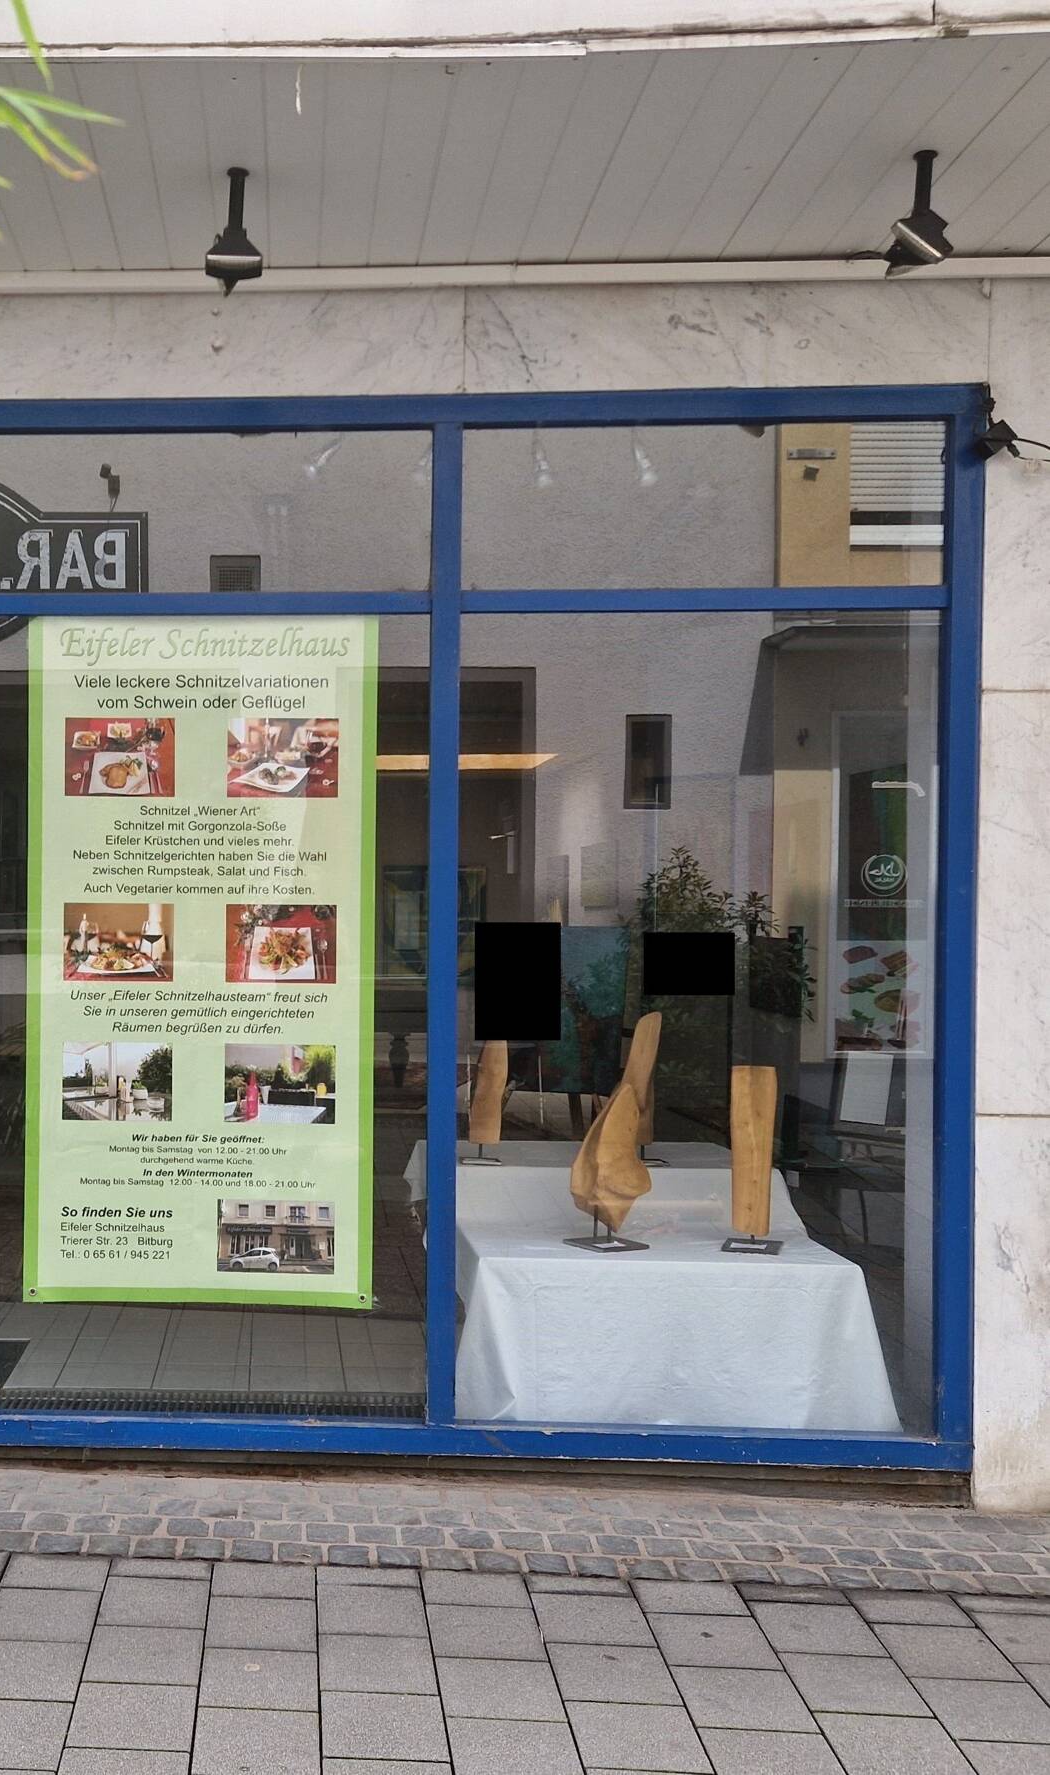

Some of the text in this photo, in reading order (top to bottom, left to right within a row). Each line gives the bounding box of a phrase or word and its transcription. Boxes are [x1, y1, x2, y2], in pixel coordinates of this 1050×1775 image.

[59, 627, 351, 667] Eifeler Schnitzelhaus
[75, 675, 329, 689] Viele leckere Schnitzelvariationen
[97, 695, 306, 712] vom Schwein oder Geflügel
[140, 806, 191, 816] Schnitzel
[114, 820, 287, 834] Schnitzel mit Gorgonzola-Soße
[105, 835, 295, 847] Eifeler Krüstchen und vieles mehr.
[73, 850, 327, 864] Neben Schnitzelgerichten haben Sie die Wahl
[92, 866, 307, 879] zwischen Rumpsteak, Salat und Fisch.
[84, 883, 315, 897] Auch Vegetarier kommen auf ihre Kosten.
[70, 990, 106, 1001] Unser
[274, 992, 301, 1003] freut
[304, 992, 328, 1003] sich
[83, 1006, 315, 1021] Sie in unseren gemütlich eingerichteten
[112, 1021, 284, 1036] Räumen begrüßen zu dürfen.
[131, 1134, 265, 1146] Wir haben für Sie geöffnet:
[109, 1146, 140, 1155] Montag
[142, 1146, 154, 1154] bis
[157, 1146, 193, 1155] Samstag
[271, 1147, 287, 1155] Uhr
[140, 1157, 194, 1166] durchgehend
[143, 1169, 253, 1178] In den Wintermonaten
[80, 1178, 111, 1187] Montag
[113, 1178, 125, 1186] bis
[128, 1178, 164, 1188] Samstag
[225, 1180, 241, 1188] und
[300, 1181, 316, 1189] Uhr
[61, 1206, 173, 1218] So finden Sie uns
[60, 1222, 165, 1233] Eifeler Schnitzelhaus
[60, 1235, 173, 1249] Trierer Str. 23 Bitburg
[83, 1250, 90, 1259] 0
[93, 1250, 106, 1259] 65
[109, 1250, 120, 1259] 61
[130, 1250, 149, 1260] 945
[152, 1251, 170, 1260] 221
